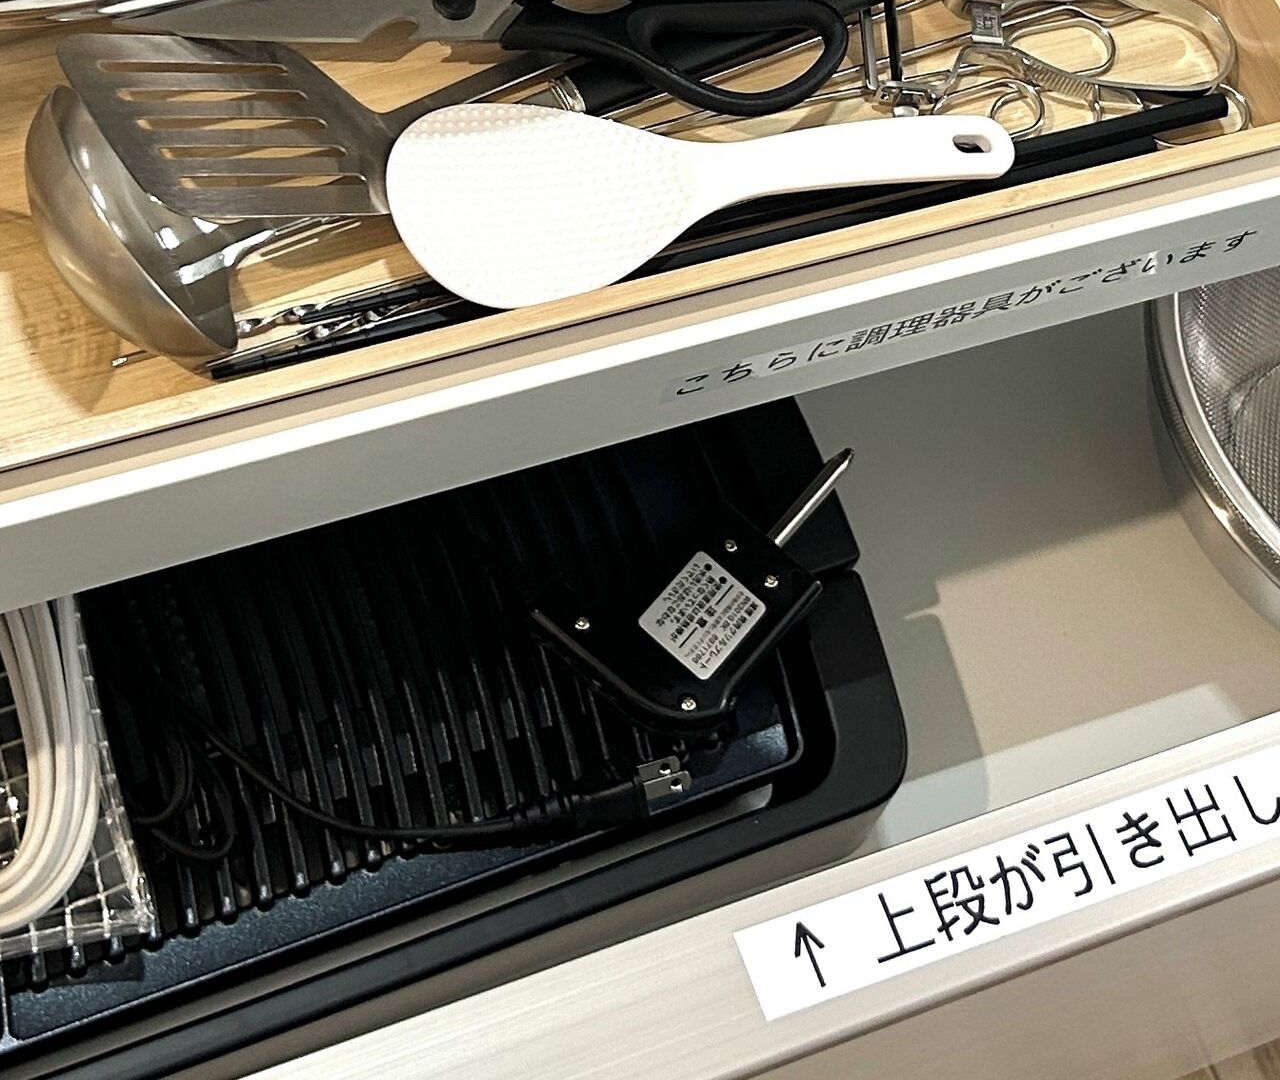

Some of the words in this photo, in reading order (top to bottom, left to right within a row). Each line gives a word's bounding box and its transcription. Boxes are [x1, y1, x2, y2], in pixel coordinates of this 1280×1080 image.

[675, 229, 1258, 397] こちらに調理器具がございます
